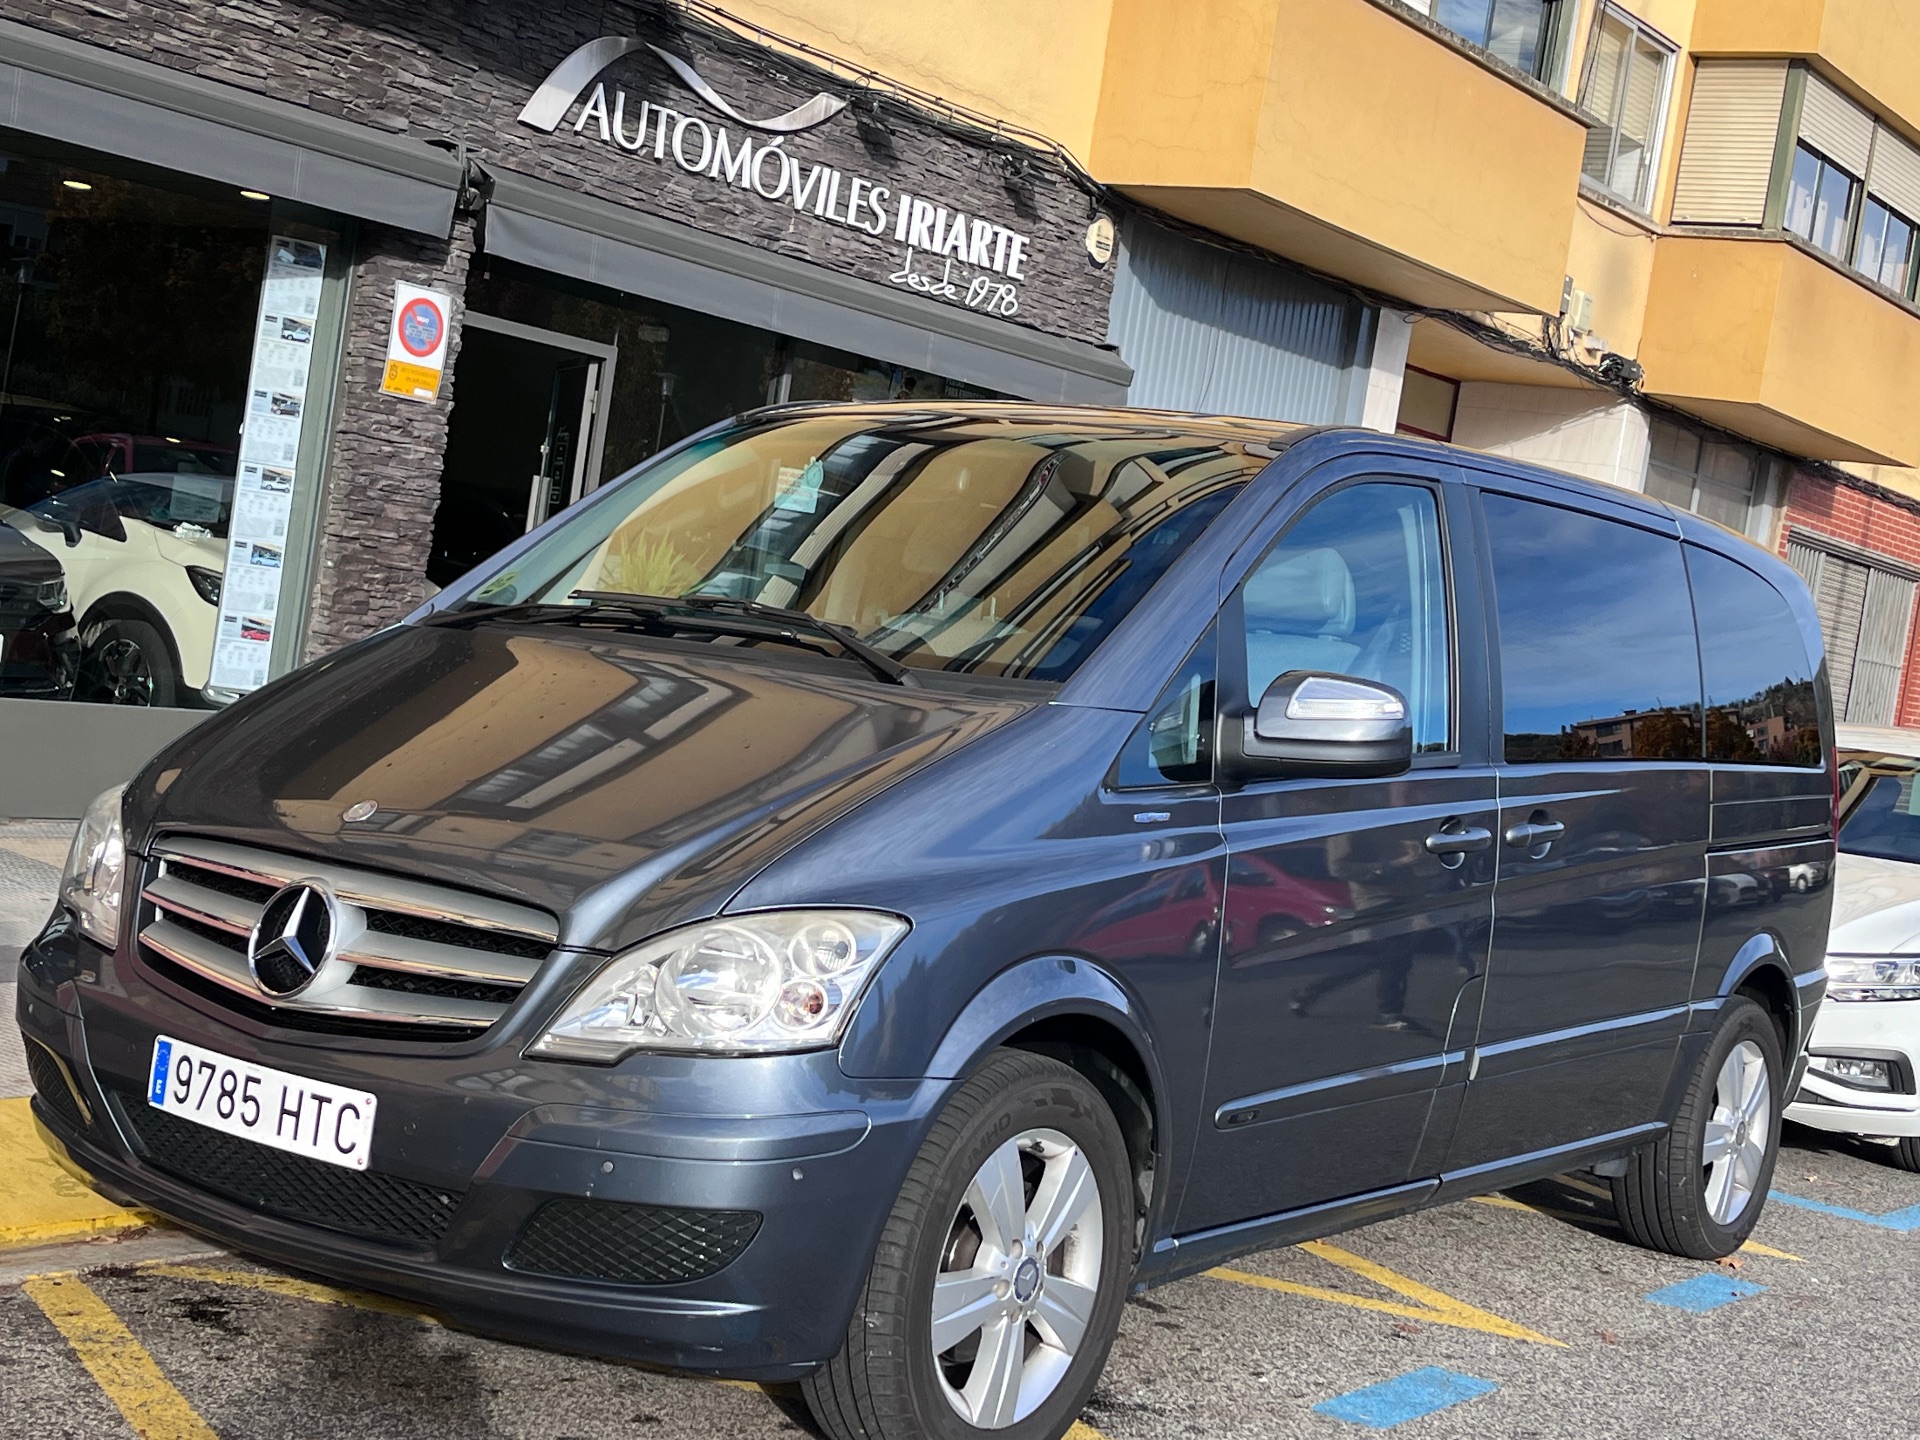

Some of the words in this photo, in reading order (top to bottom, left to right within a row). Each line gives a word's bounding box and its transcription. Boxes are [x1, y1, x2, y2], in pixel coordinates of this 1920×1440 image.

[573, 82, 891, 236] AUTOMÓVILES
[894, 195, 1031, 281] IRIARTE
[888, 246, 958, 300] desde
[964, 275, 1019, 316] 1978
[155, 1079, 163, 1095] E
[173, 1054, 262, 1127] 9785
[276, 1085, 361, 1155] HTC
